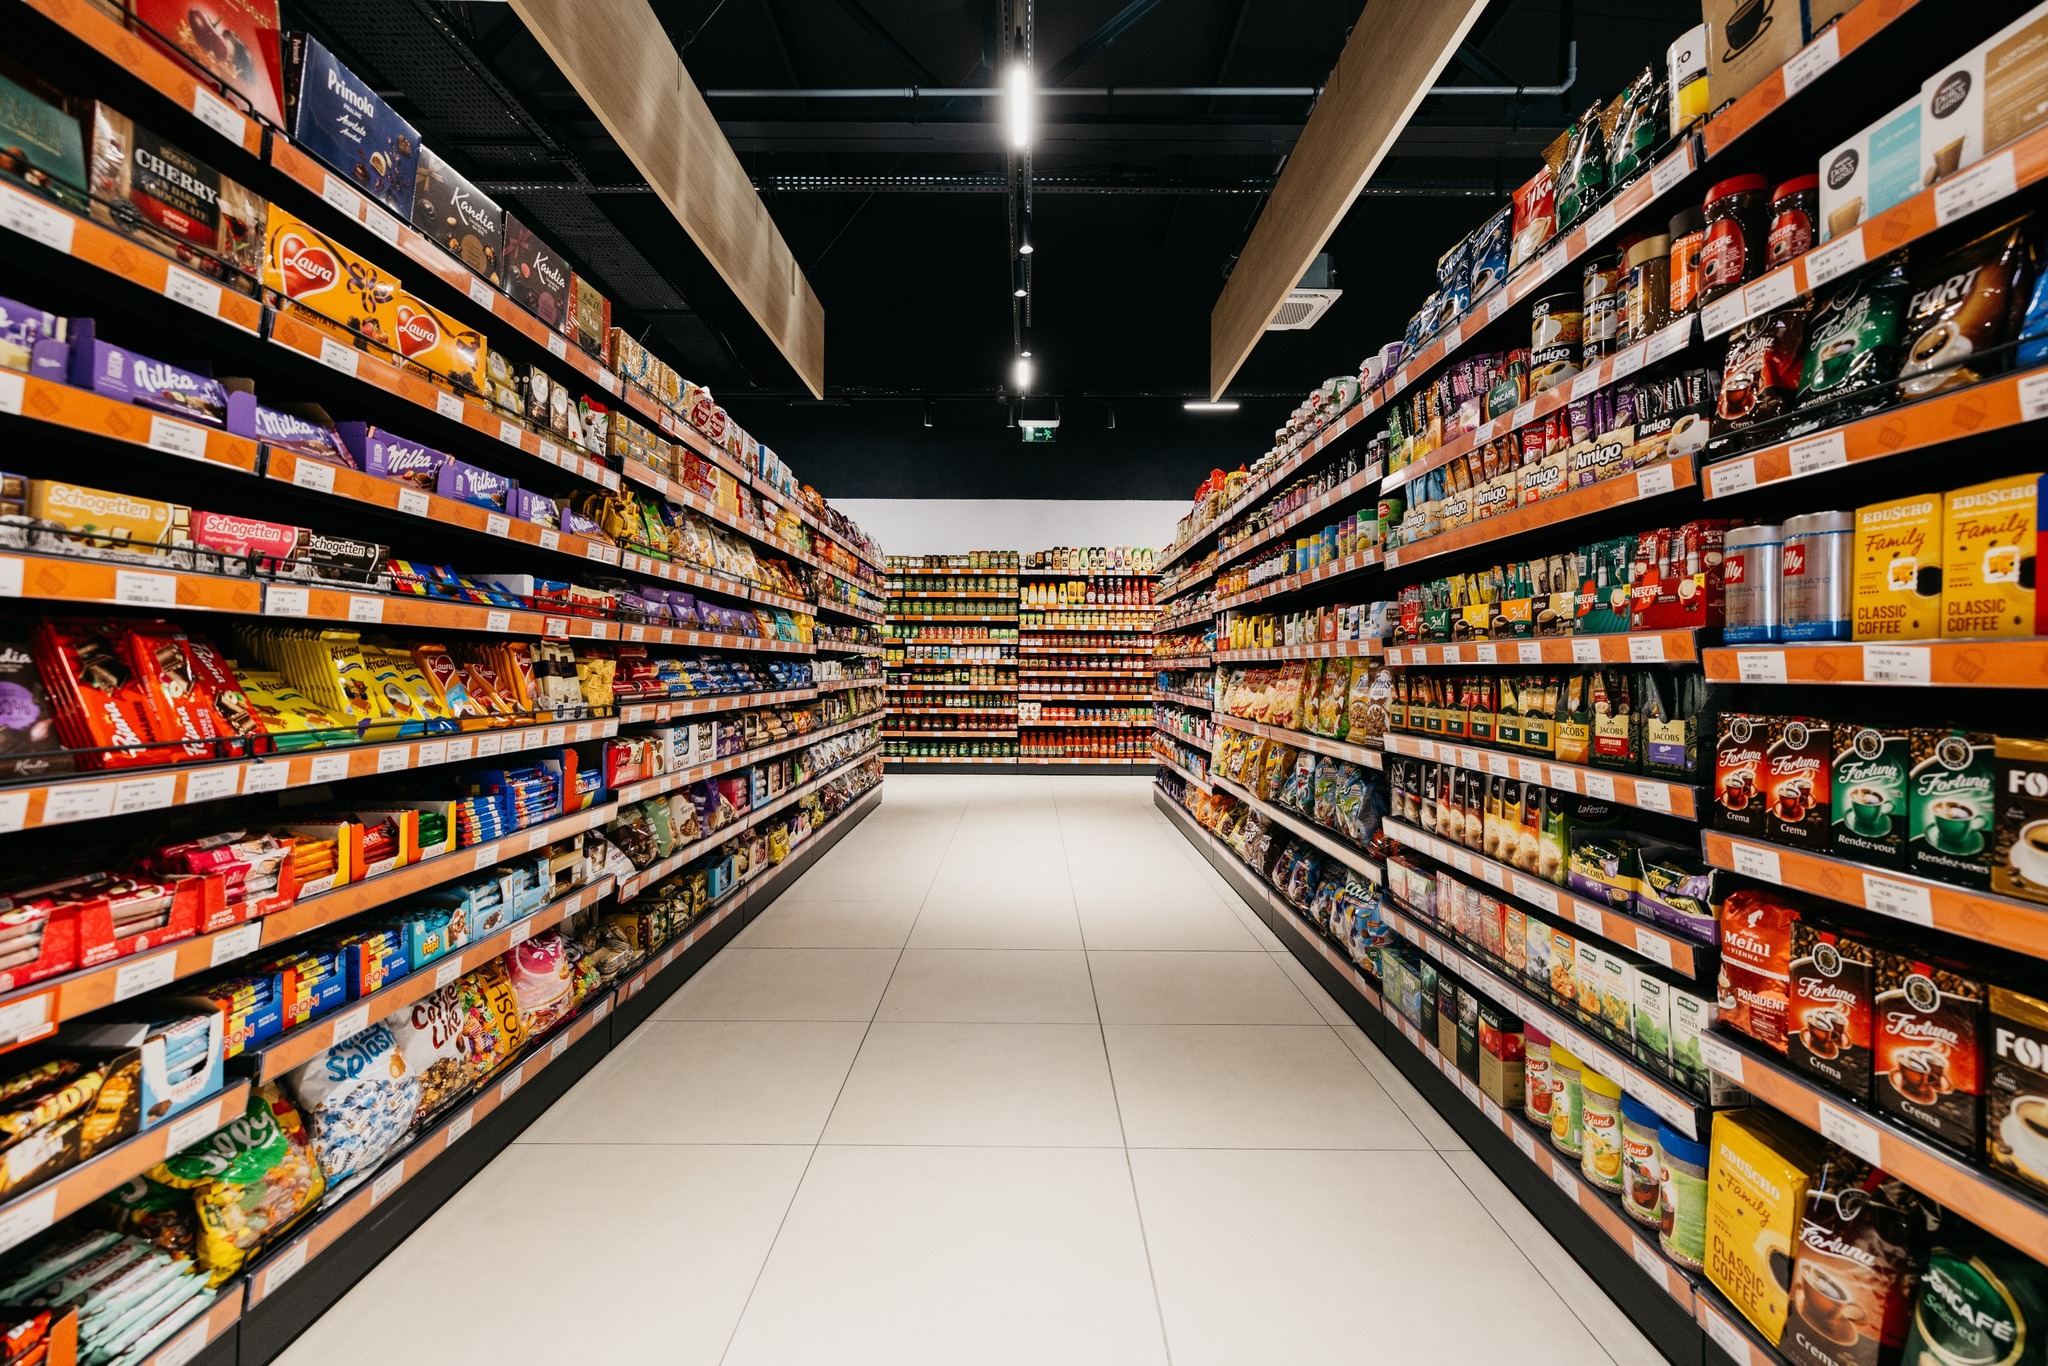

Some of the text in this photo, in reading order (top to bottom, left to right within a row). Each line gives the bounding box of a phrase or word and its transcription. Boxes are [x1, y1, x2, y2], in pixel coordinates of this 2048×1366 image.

[328, 68, 374, 118] Primola
[135, 148, 218, 204] CHERRY
[451, 187, 495, 232] Kandia
[284, 250, 332, 281] Laura
[533, 252, 565, 288] Kandia
[1906, 266, 1984, 320] FORT
[399, 320, 435, 342] Laura
[134, 360, 198, 393] Milka
[407, 363, 445, 385] CIOCOATA
[1666, 382, 1674, 410] Amigo
[1692, 376, 1701, 404] Amigo
[256, 406, 314, 438] Milka
[1640, 418, 1671, 437] Amigo
[387, 444, 432, 473] Milka
[1575, 442, 1622, 472] Amigo
[465, 469, 498, 495] Milka
[1524, 466, 1560, 490] Amigo
[48, 485, 151, 520] Schogetten
[1477, 485, 1507, 507] Amigo
[1952, 484, 2037, 511] EDUSCHO
[1443, 500, 1467, 518] Amigo
[1862, 502, 1932, 525] EDUSCHO
[204, 515, 281, 541] Schogetten
[1406, 511, 1426, 530] Amigo
[1956, 512, 2030, 545] Family
[310, 534, 366, 557] Schogetten
[1866, 527, 1926, 556] Family
[1725, 560, 1742, 582] illy
[1784, 550, 1804, 573] illy
[1471, 607, 1488, 626] 3in1
[1510, 602, 1529, 622] 3in1
[1858, 604, 1907, 620] CLASSIC
[1948, 598, 2006, 616] CLASSIC
[1431, 612, 1446, 630] 3in1
[1857, 620, 1901, 635] COFFEE
[1947, 616, 1999, 633] COFFEE
[331, 645, 360, 662] Africana
[364, 658, 394, 673] Africana
[432, 660, 453, 673] Laura
[1448, 712, 1462, 720] JACOBS
[1474, 715, 1488, 723] JACOBS
[1502, 717, 1518, 726] JACOBS
[1527, 720, 1544, 730] JACOBS
[1558, 725, 1584, 738] JACOBS
[1600, 726, 1624, 736] JACOBS
[1653, 732, 1680, 742] JACOBS
[1719, 748, 1762, 768] Fortuna
[1770, 755, 1820, 776] Fortuna
[1838, 762, 1898, 784] Fortuna
[1918, 772, 1991, 797] Fortuna
[1578, 804, 1608, 814] LaFesta
[1726, 811, 1750, 824] Crema
[1780, 823, 1808, 836] Crema
[424, 846, 444, 858] ROSHEN
[1838, 834, 1896, 854] Rendez-vous
[370, 862, 393, 875] ROSHEN
[1580, 866, 1604, 880] JACOBS
[304, 880, 332, 895] ROSHEN
[422, 935, 440, 956] Papi
[1724, 930, 1770, 958] Meinl
[1730, 948, 1759, 963] VIENNA
[365, 964, 389, 987] ROM
[1798, 976, 1857, 1005] Fortuna
[288, 993, 320, 1020] ROM
[1480, 1009, 1498, 1028] Greenfield
[1886, 1012, 1960, 1045] Fortuna
[222, 1022, 255, 1051] ROM
[432, 1012, 462, 1050] Like
[326, 1025, 396, 1082] Splash
[1809, 1056, 1842, 1080] Crema
[1584, 1108, 1610, 1128] Ekland
[1901, 1100, 1942, 1128] Crema
[1623, 1137, 1648, 1156] Ekland
[1720, 1144, 1781, 1200] EDUSCHO
[1726, 1172, 1772, 1228] Family
[1799, 1218, 1876, 1268] Fortuna
[1714, 1234, 1765, 1298] CLASSIC
[1712, 1254, 1759, 1313] COFFEE
[1796, 1332, 1840, 1366] Crema
